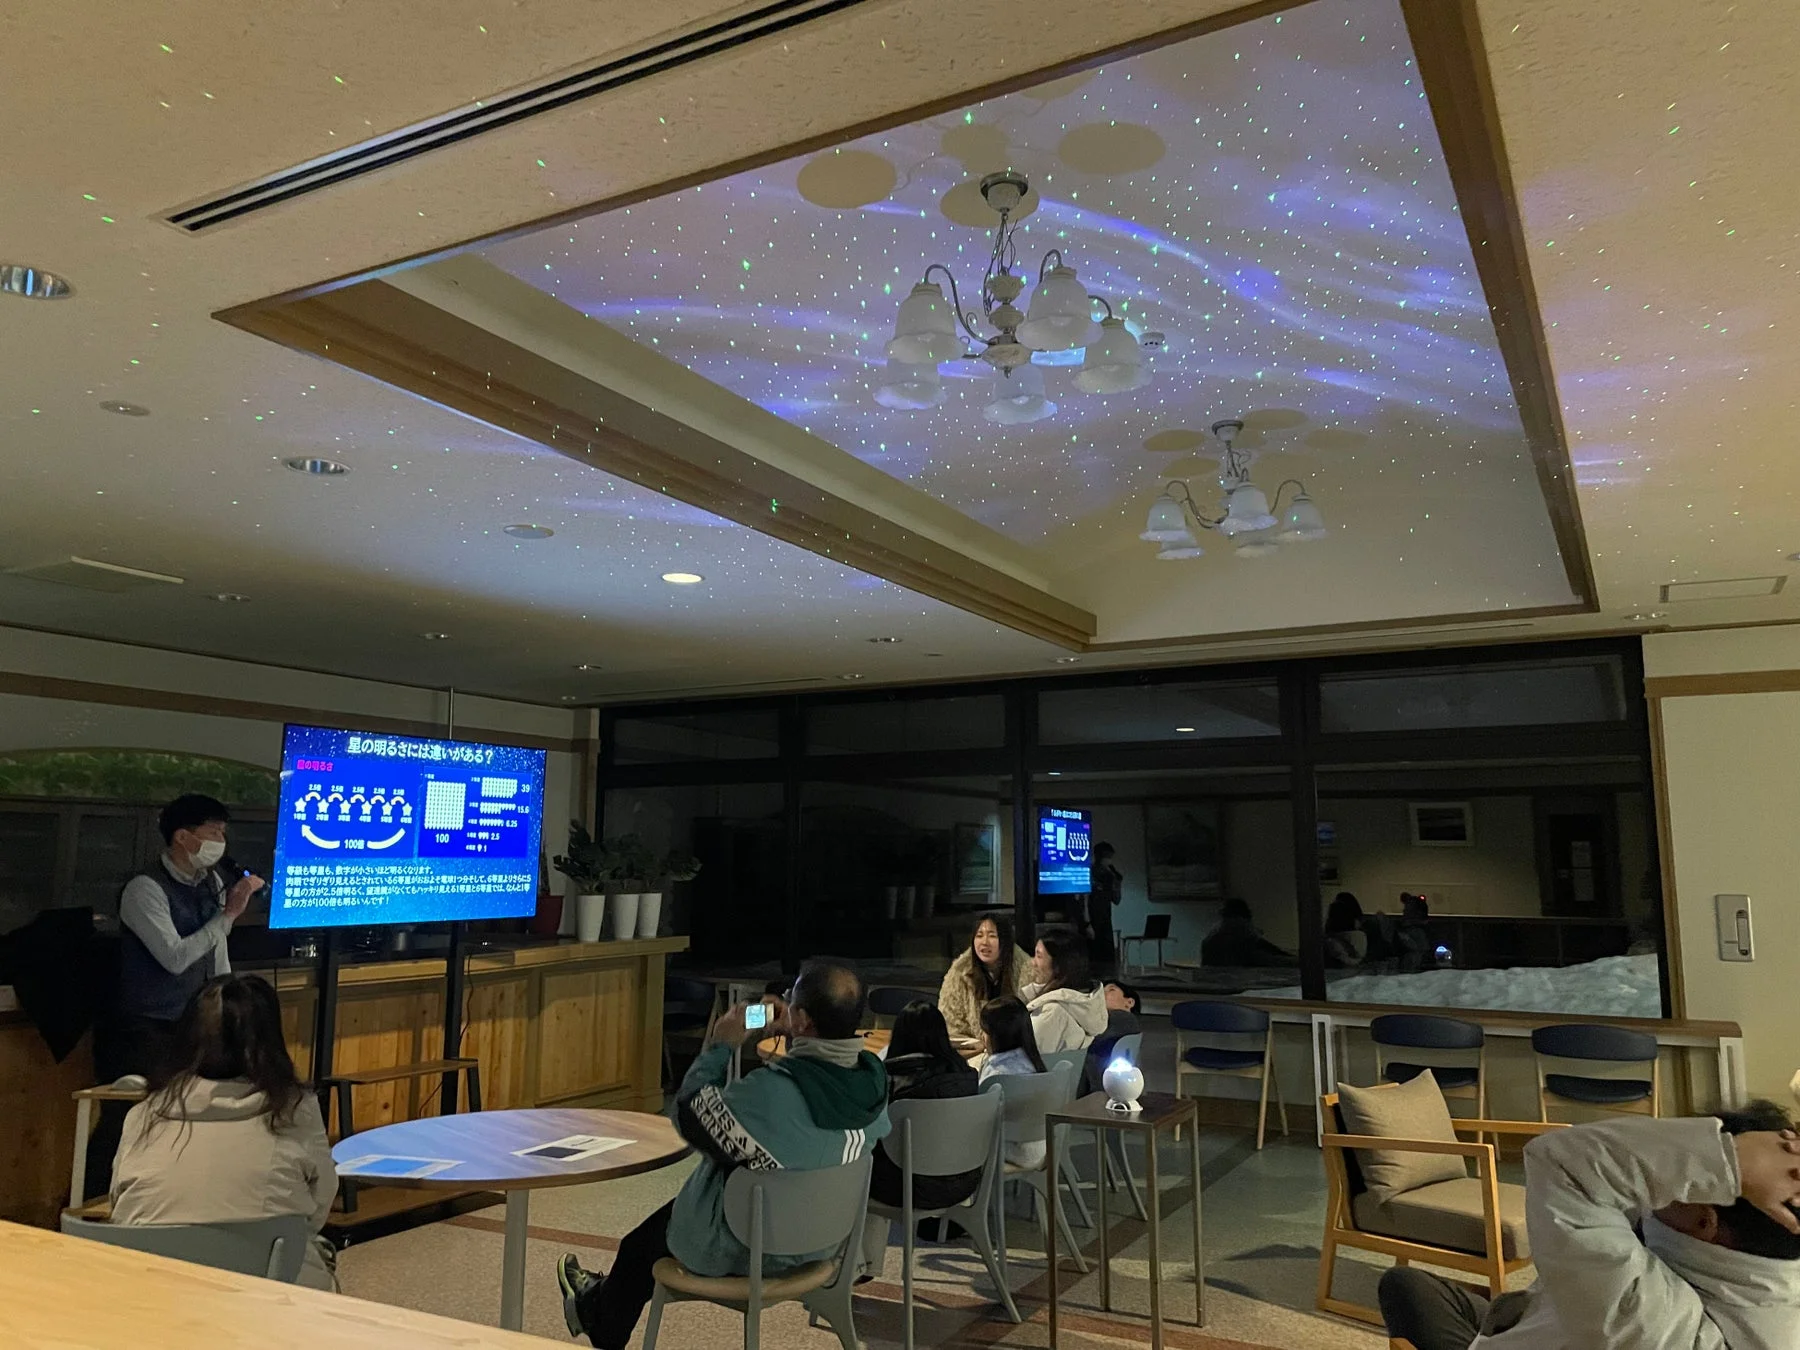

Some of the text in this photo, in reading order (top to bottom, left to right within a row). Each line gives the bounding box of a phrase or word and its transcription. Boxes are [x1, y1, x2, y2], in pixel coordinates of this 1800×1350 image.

[347, 736, 494, 764] 星の明るさには違いがある？
[520, 783, 530, 793] 39
[435, 833, 450, 843] 100
